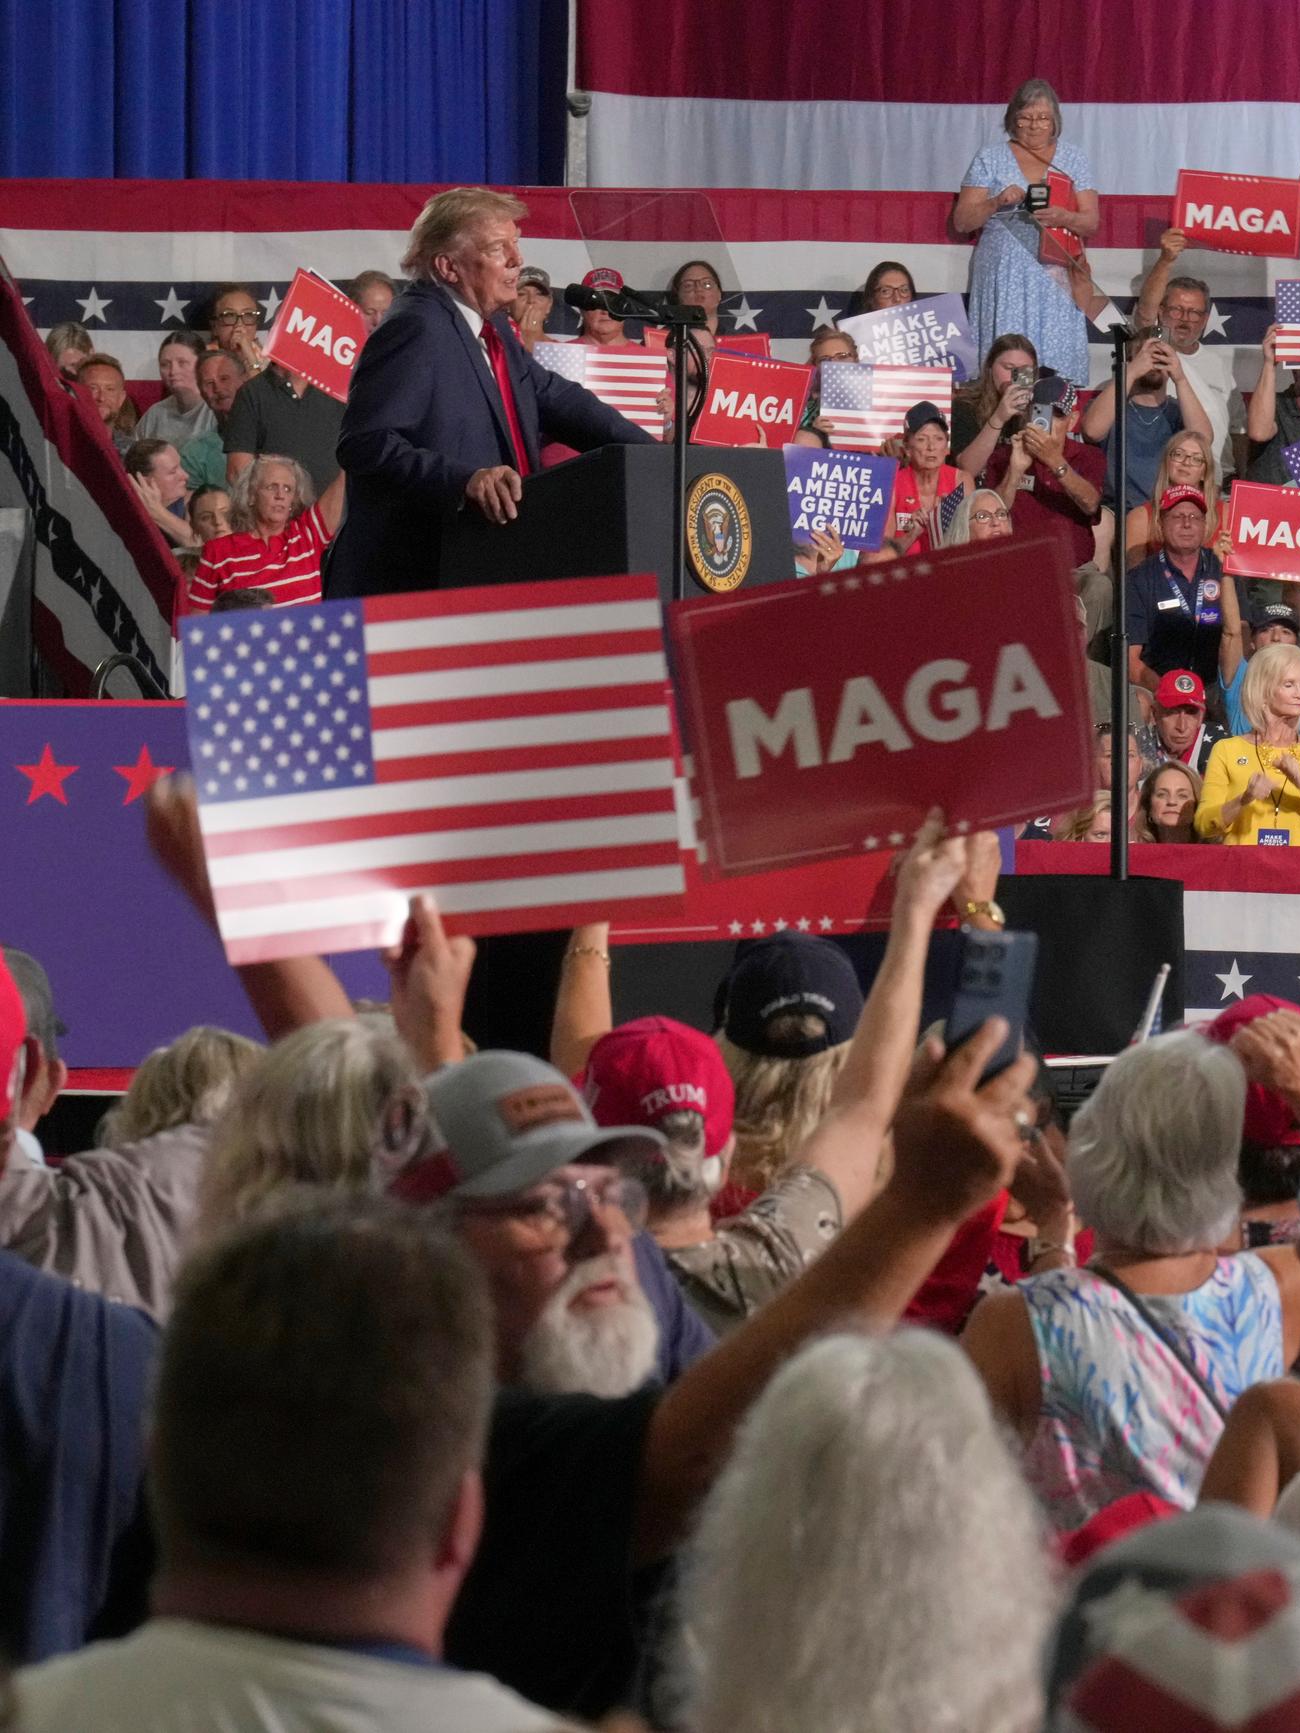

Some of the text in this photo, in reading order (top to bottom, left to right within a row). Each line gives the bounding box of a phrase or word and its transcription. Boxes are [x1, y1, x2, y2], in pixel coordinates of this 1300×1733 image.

[1184, 202, 1291, 235] MAGA
[285, 306, 358, 370] MAG
[872, 310, 938, 340] MAKE
[858, 322, 962, 361] AMERICA
[709, 388, 793, 425] MAGA
[811, 462, 872, 486] MAKE
[689, 478, 715, 530] PRESIDENT
[787, 476, 883, 505] AMERICA
[800, 496, 870, 520] GREAT
[793, 513, 868, 537] AGAIN!
[1171, 584, 1190, 611] TRUMP
[725, 642, 1063, 780] MAGA
